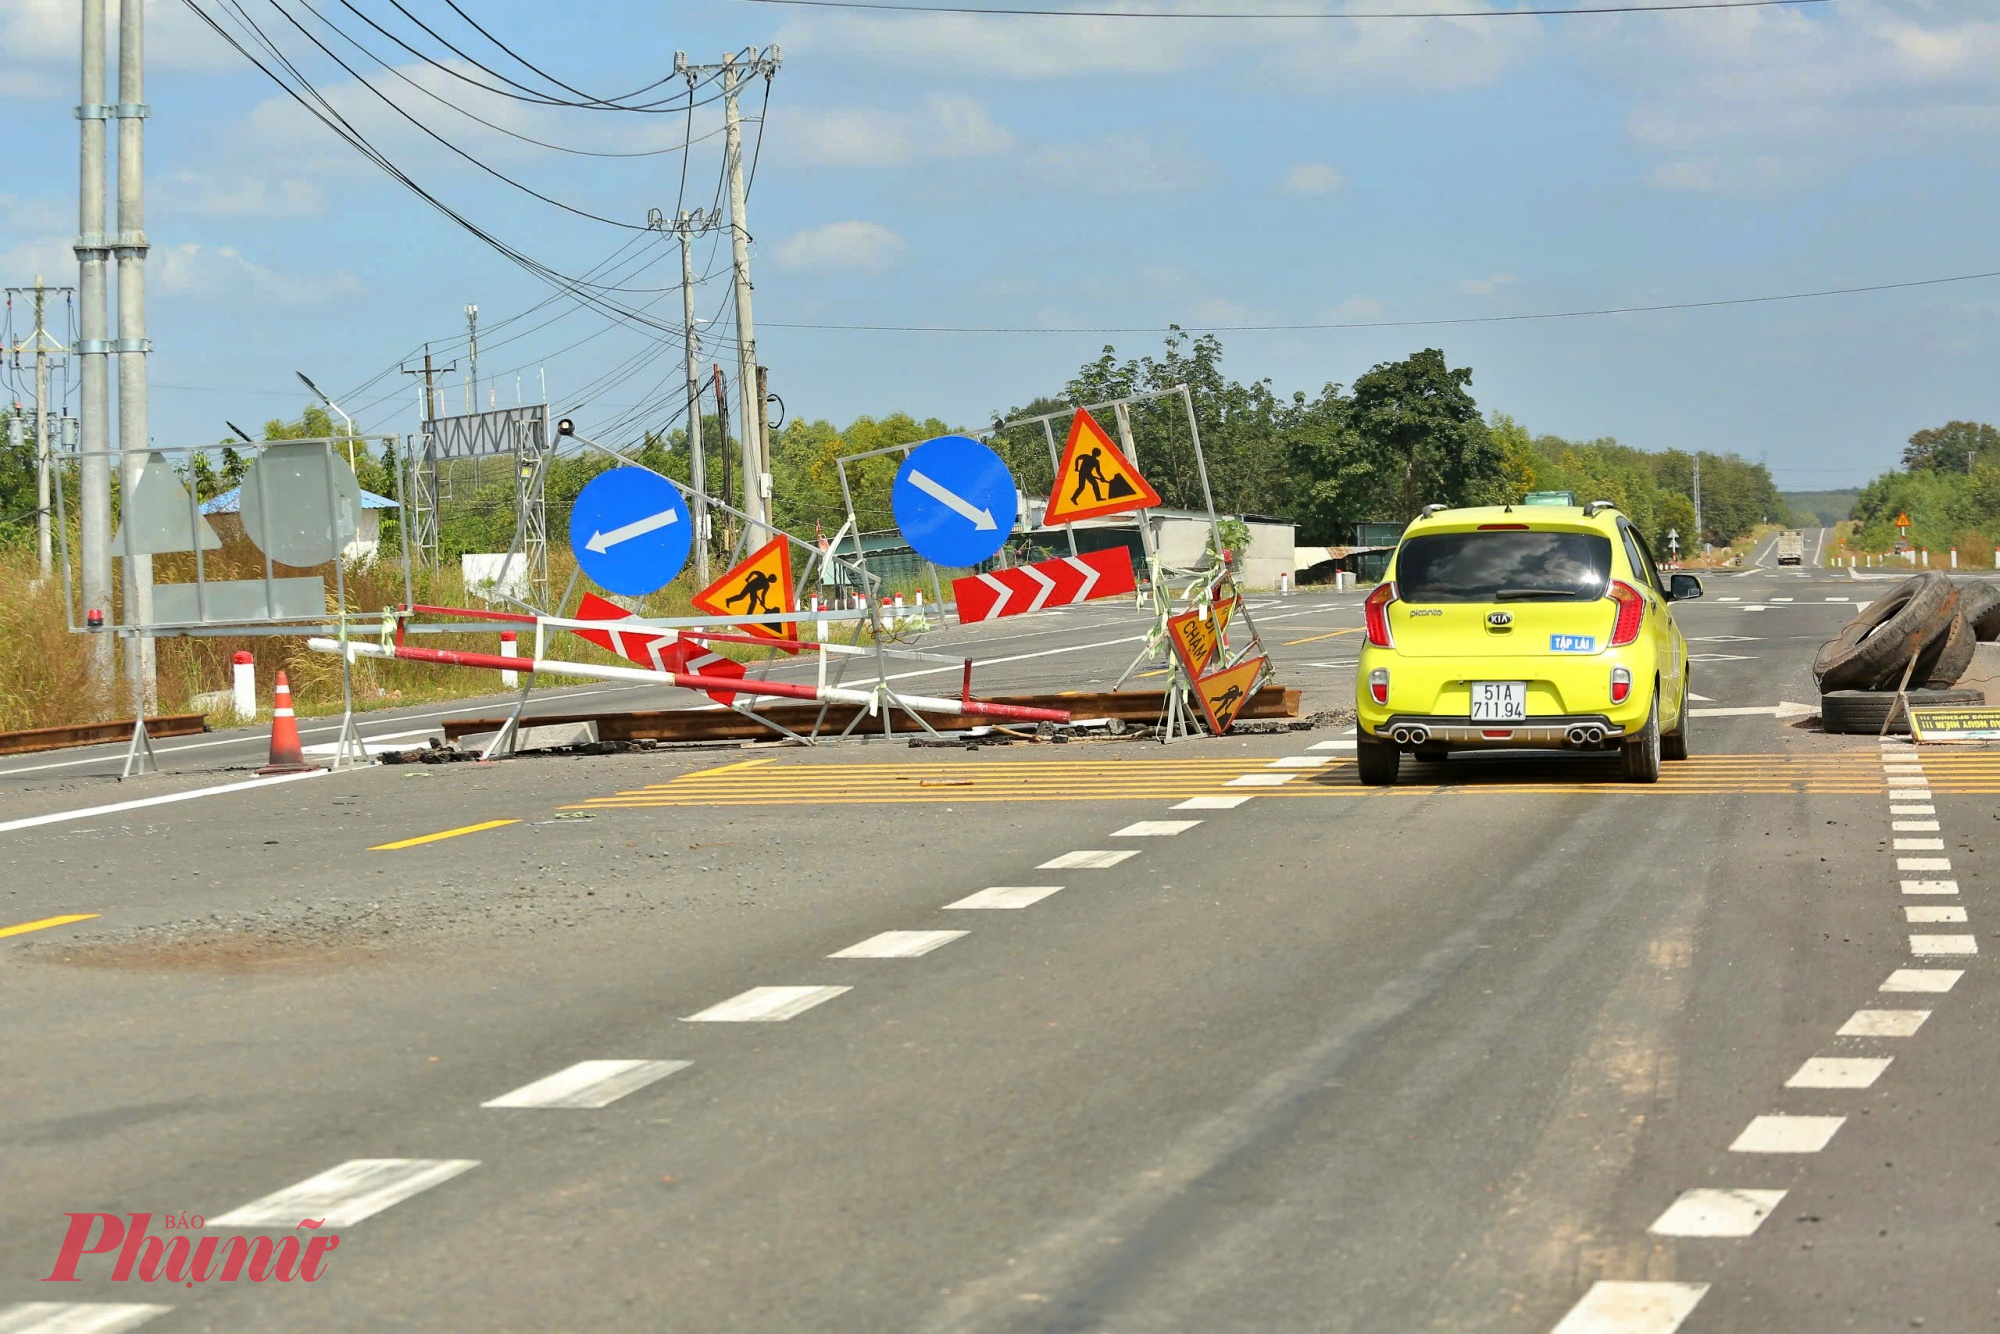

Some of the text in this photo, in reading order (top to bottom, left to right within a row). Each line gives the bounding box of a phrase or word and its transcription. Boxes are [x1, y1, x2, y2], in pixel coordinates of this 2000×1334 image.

[1490, 613, 1510, 624] KIA
[1183, 620, 1208, 661] CHẬM
[1555, 636, 1590, 651] TẬP LÁI
[1484, 684, 1512, 701] 51A
[1473, 701, 1523, 718] 711.94
[1963, 720, 1988, 728] NGUY
